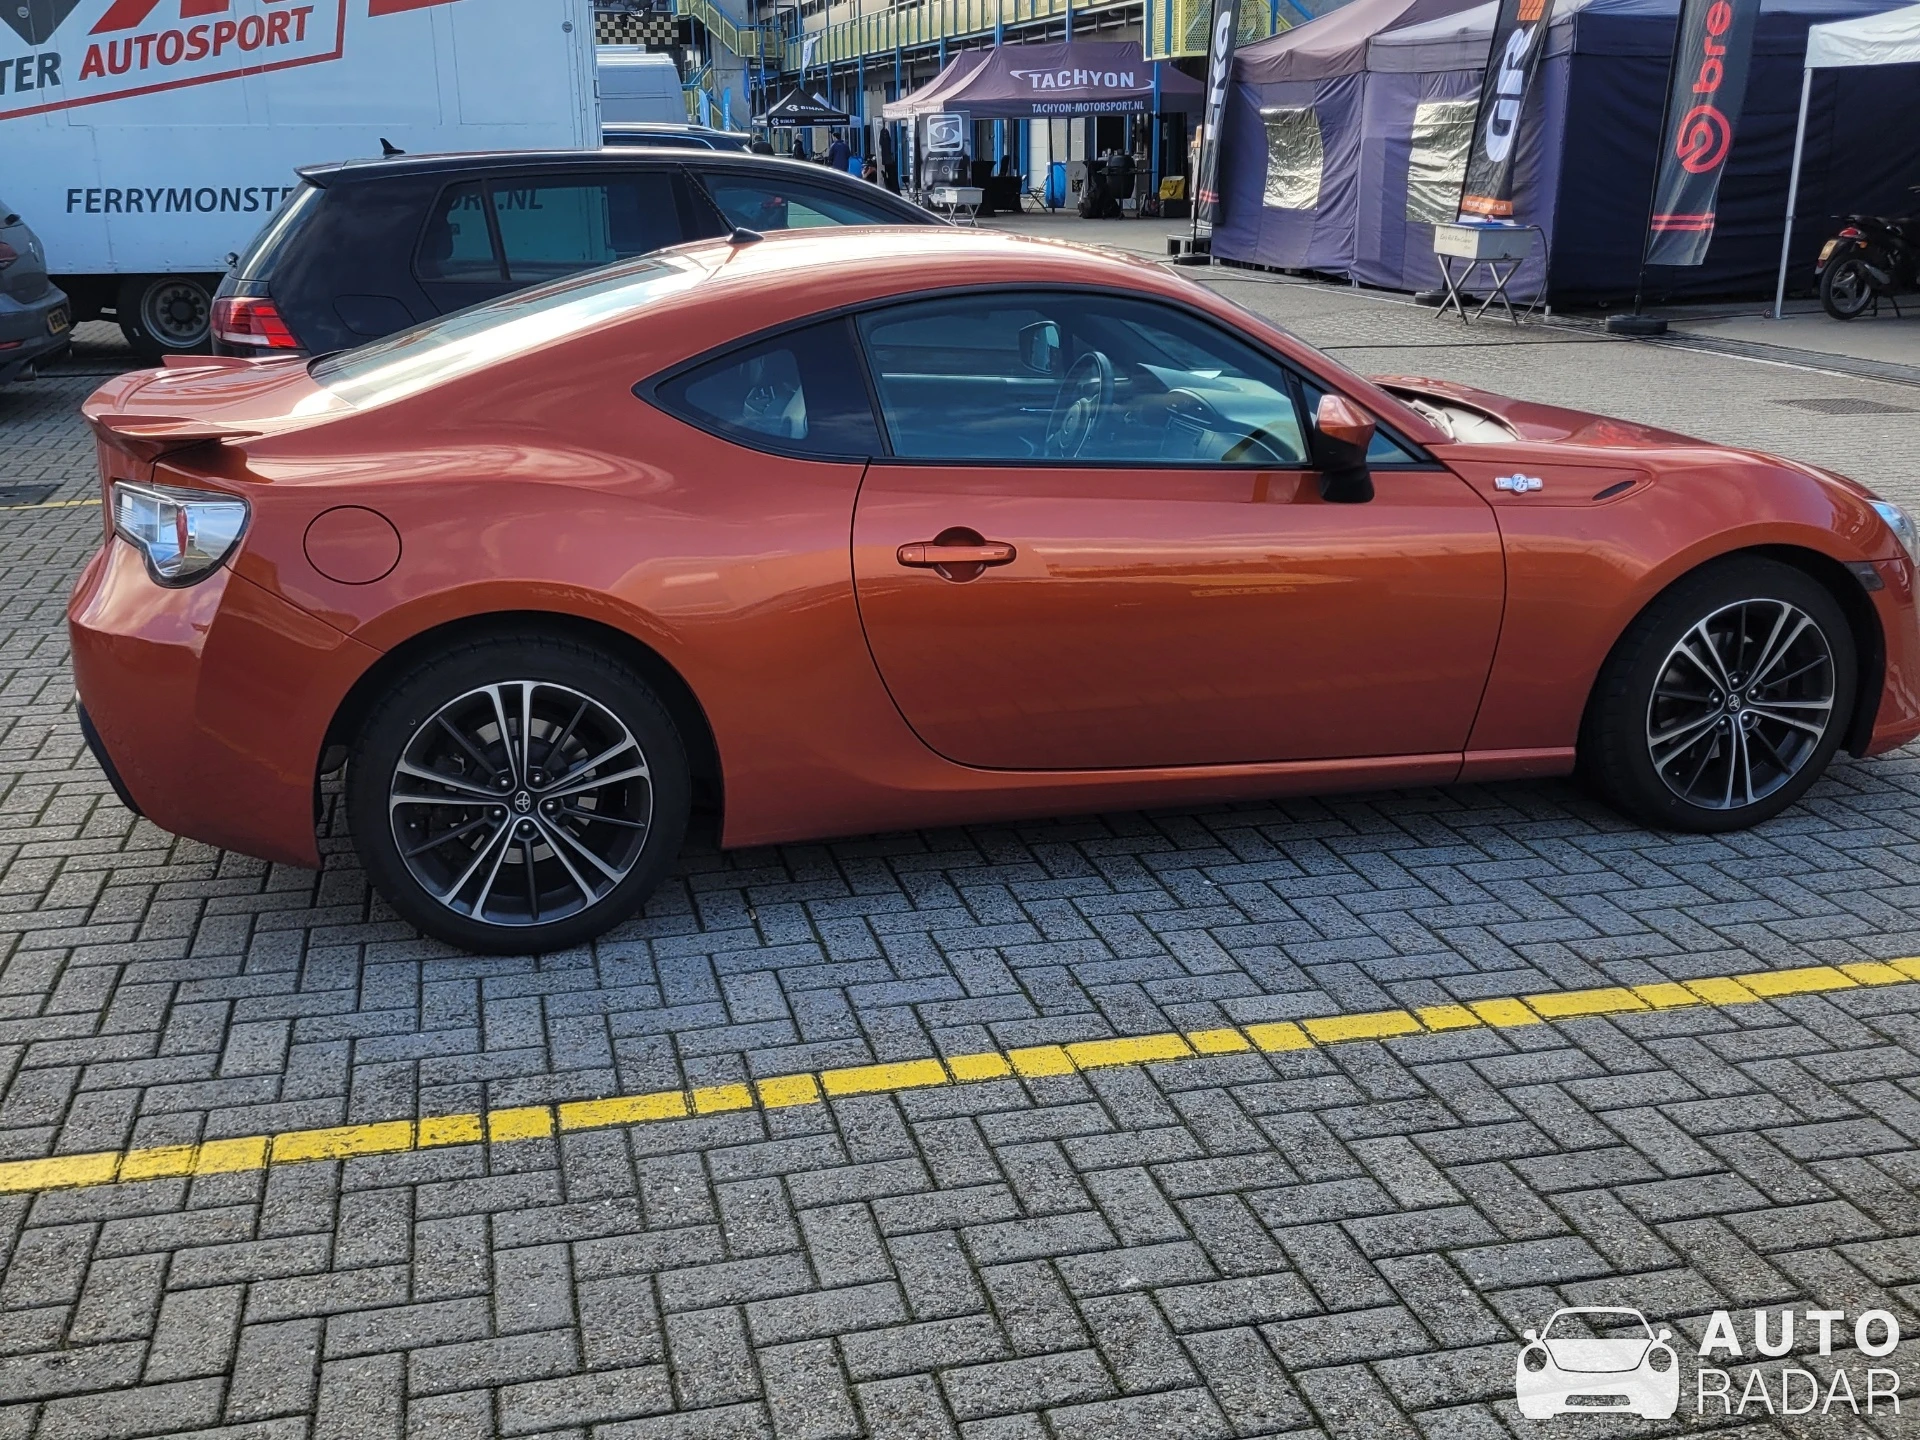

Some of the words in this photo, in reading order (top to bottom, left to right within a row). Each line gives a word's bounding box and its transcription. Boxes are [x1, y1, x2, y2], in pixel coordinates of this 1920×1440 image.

[79, 5, 314, 81] AUTOSPORT
[1028, 69, 1134, 89] TACHYON
[1486, 23, 1537, 162] GR
[1032, 100, 1144, 113] TACHYON-MOTORSPORT.NL
